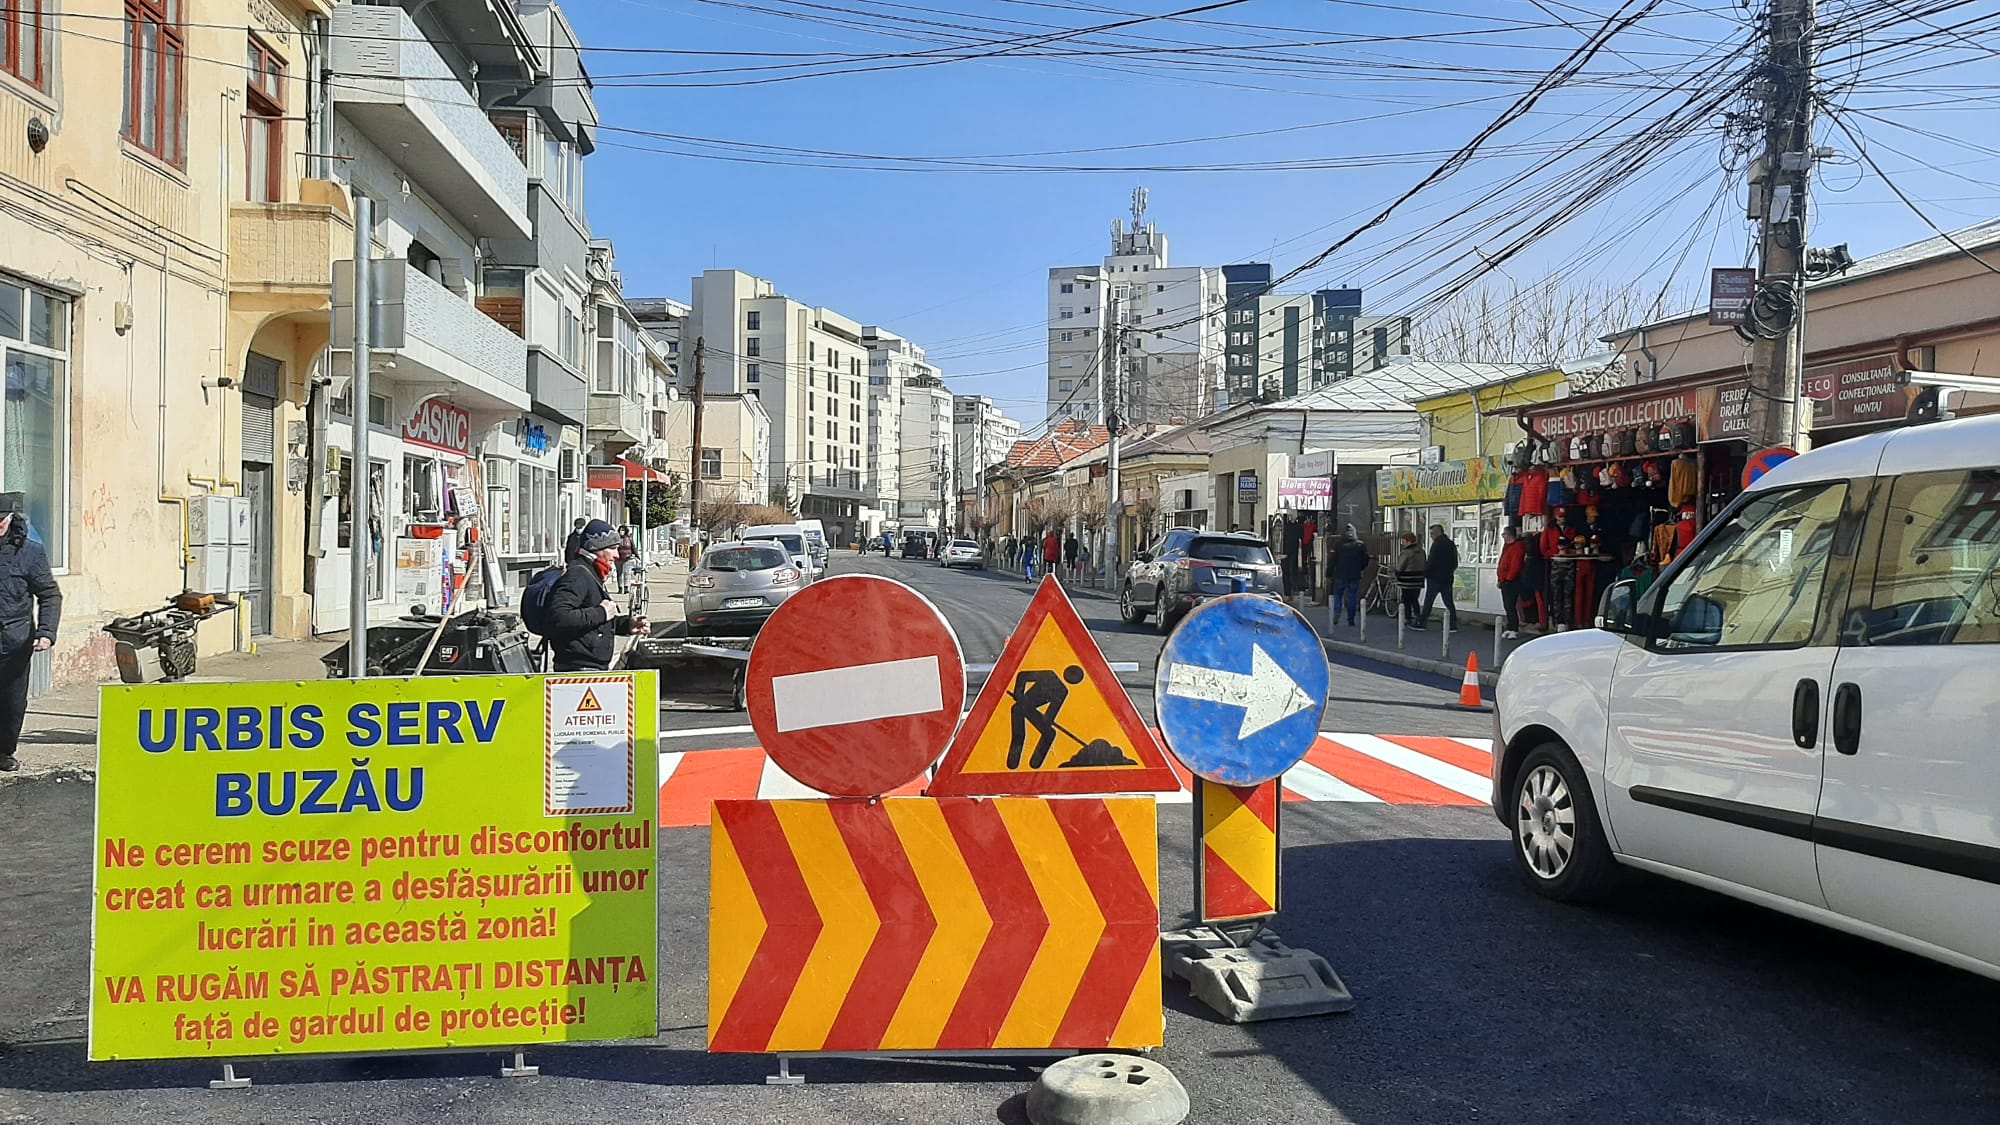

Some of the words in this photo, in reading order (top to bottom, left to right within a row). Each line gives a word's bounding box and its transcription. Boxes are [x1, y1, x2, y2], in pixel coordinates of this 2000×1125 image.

[1541, 416, 1570, 436] SIBEL
[1571, 410, 1606, 433] STYLE
[1607, 396, 1684, 427] COLLECTION
[1853, 401, 1882, 415] MONTAJ
[441, 647, 453, 655] CAT
[139, 706, 324, 753] URBIS
[347, 700, 505, 747] SERV
[565, 714, 616, 728] ATENȚIE!
[216, 759, 424, 817] BUZĂU
[105, 838, 146, 869] Ne
[156, 843, 252, 868] cerem
[263, 839, 352, 864] scuze
[362, 831, 461, 866] pentru
[471, 820, 650, 857] disconfortul
[106, 880, 186, 912] creat
[196, 886, 233, 910] ca
[244, 880, 355, 907] urmare
[365, 882, 382, 903] a
[393, 868, 572, 912] desfășurării
[583, 869, 649, 893] unor
[198, 918, 297, 952] lucrări
[309, 918, 336, 947] in
[346, 912, 468, 945] această
[477, 908, 557, 940] zonă!
[105, 977, 147, 1005] VA
[156, 966, 269, 1003] RUGĂM
[280, 963, 320, 999] SĂ
[331, 961, 483, 1000] PĂSTRAȚI
[494, 956, 646, 993] DISTANȚA
[174, 1012, 233, 1049] față
[243, 1011, 280, 1038] de
[290, 1006, 385, 1044] gardul
[394, 1004, 432, 1033] de
[441, 996, 586, 1043] protecție!
